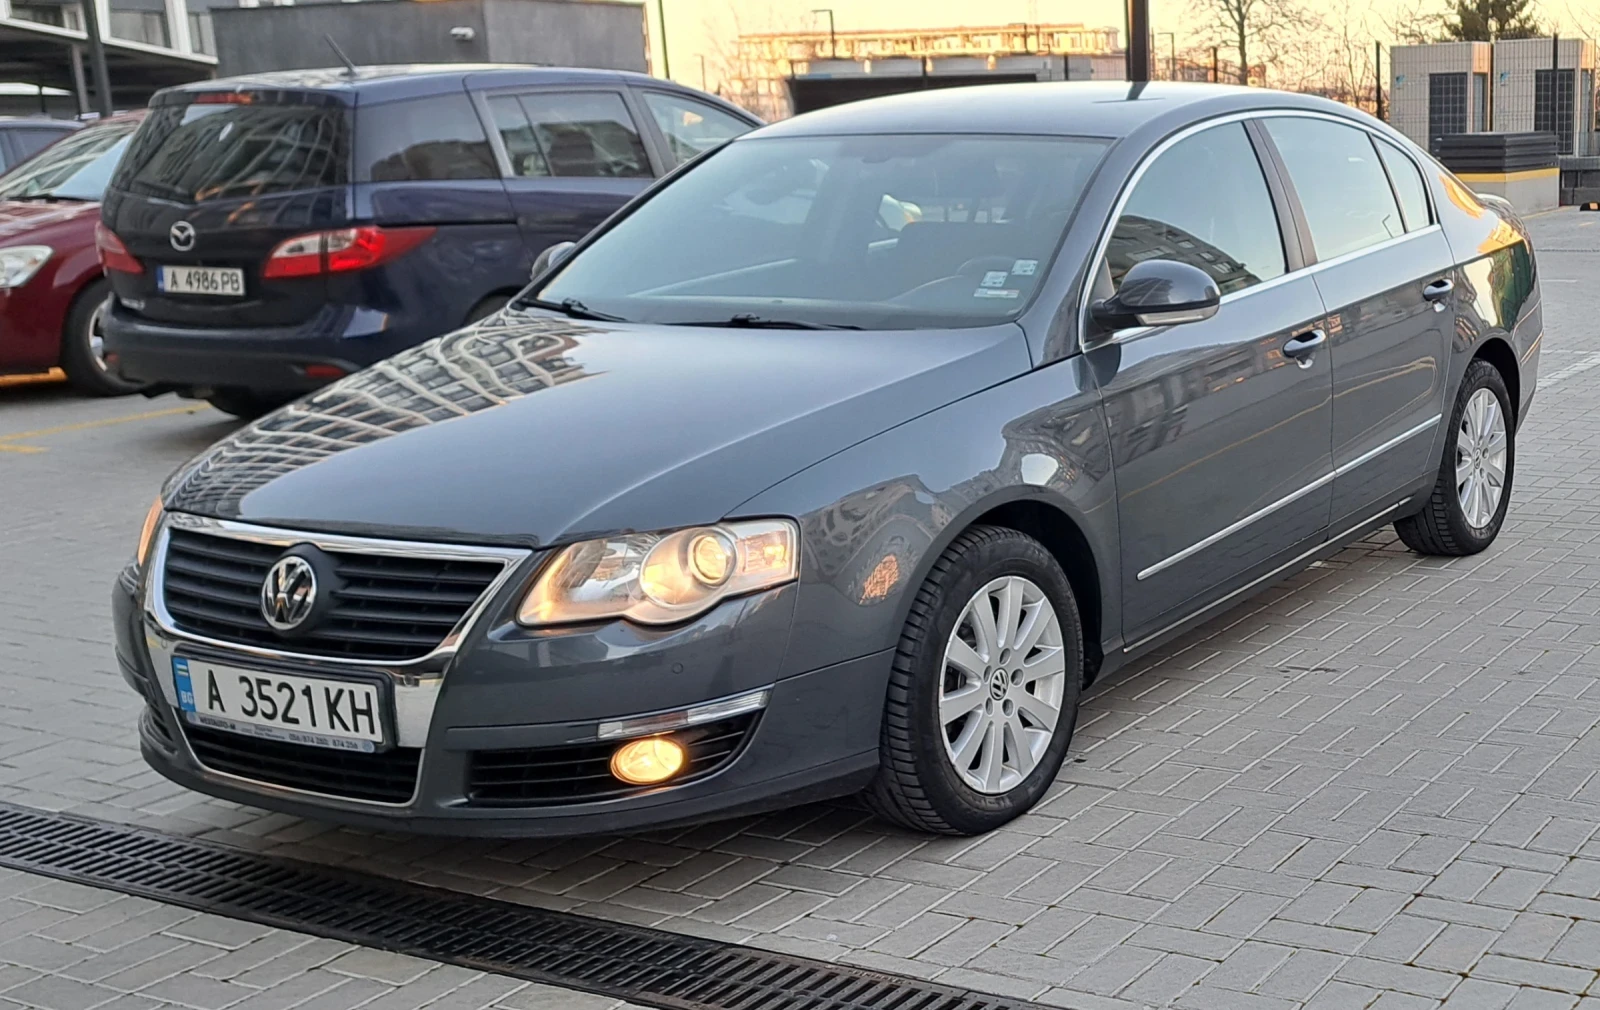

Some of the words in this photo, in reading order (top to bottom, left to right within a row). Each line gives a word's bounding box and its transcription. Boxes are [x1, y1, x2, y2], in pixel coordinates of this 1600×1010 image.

[170, 270, 179, 289] A
[181, 691, 194, 704] BG
[208, 669, 226, 713] A
